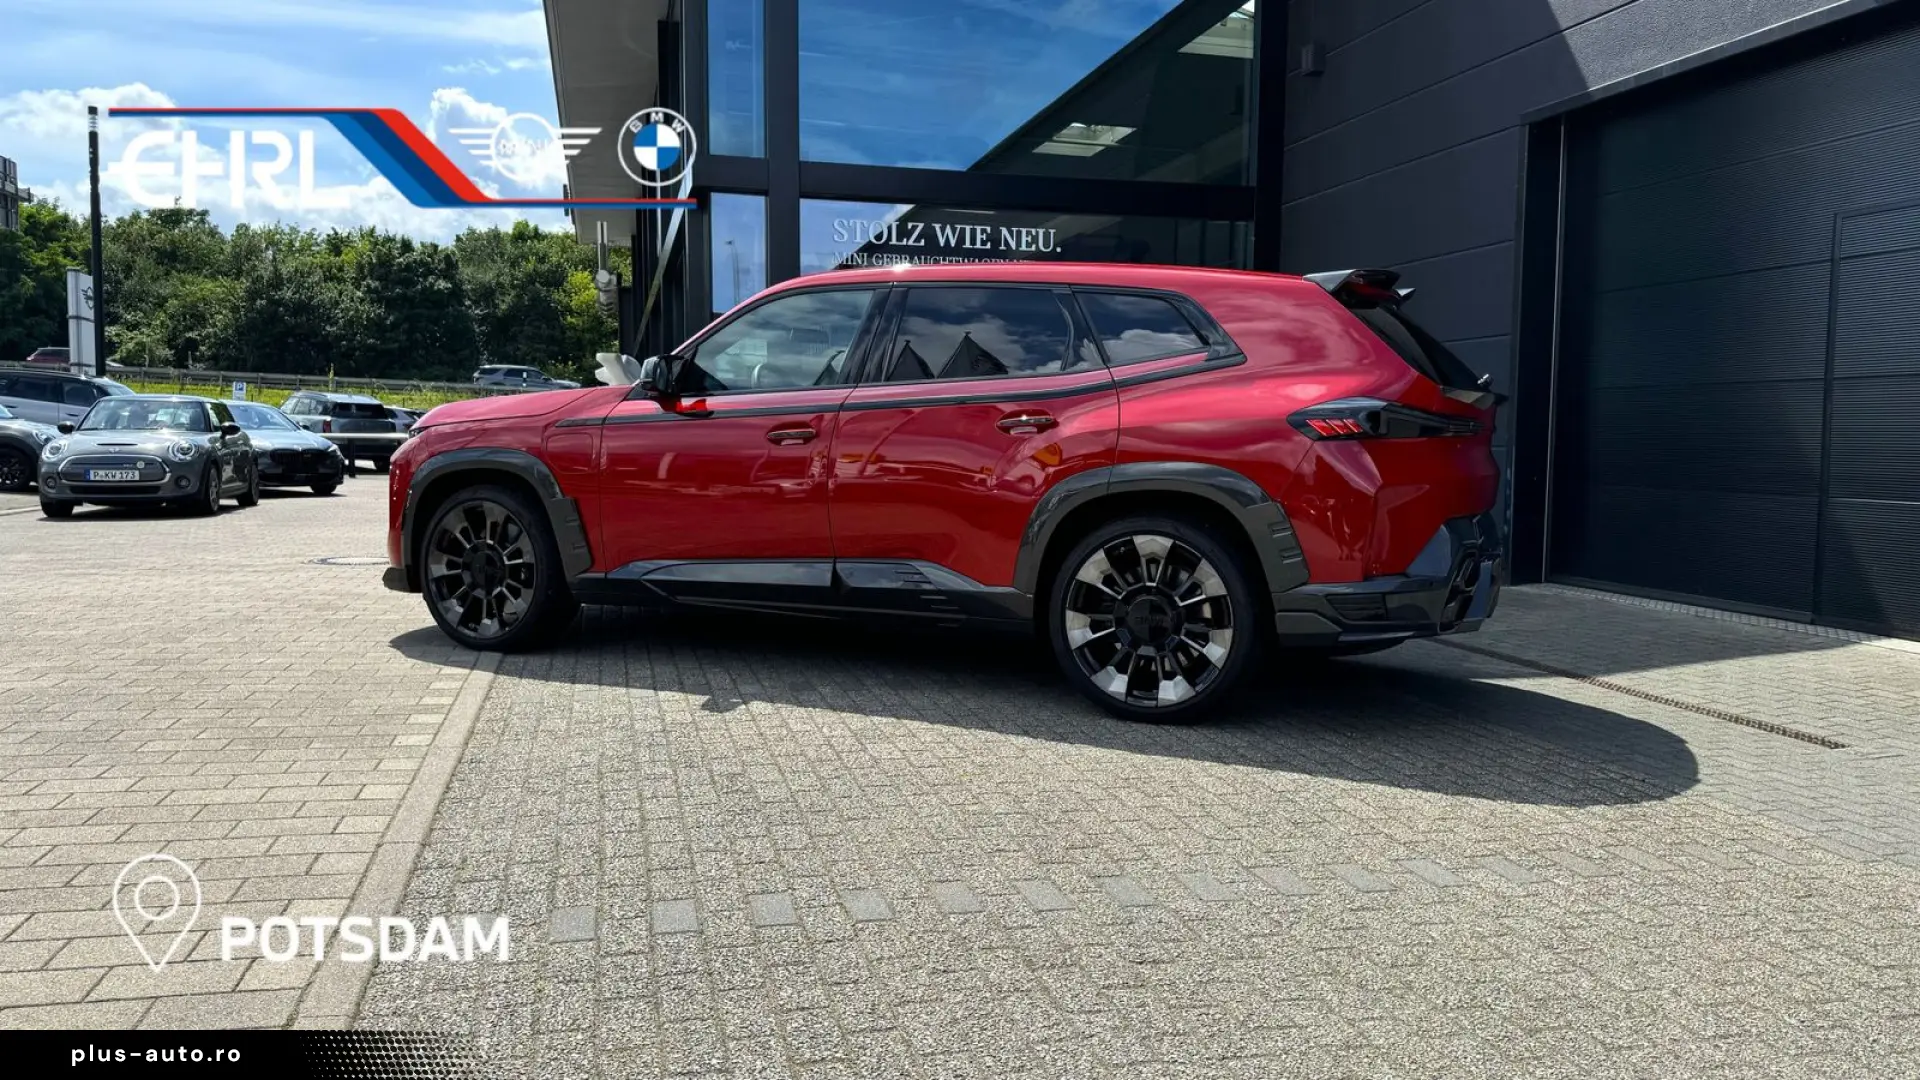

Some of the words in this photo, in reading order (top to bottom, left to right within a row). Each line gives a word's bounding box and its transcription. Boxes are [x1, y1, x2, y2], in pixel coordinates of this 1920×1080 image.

[832, 218, 925, 247] STOLZ
[932, 223, 991, 249] WIE
[999, 226, 1062, 253] NEU.
[831, 251, 868, 267] MINI
